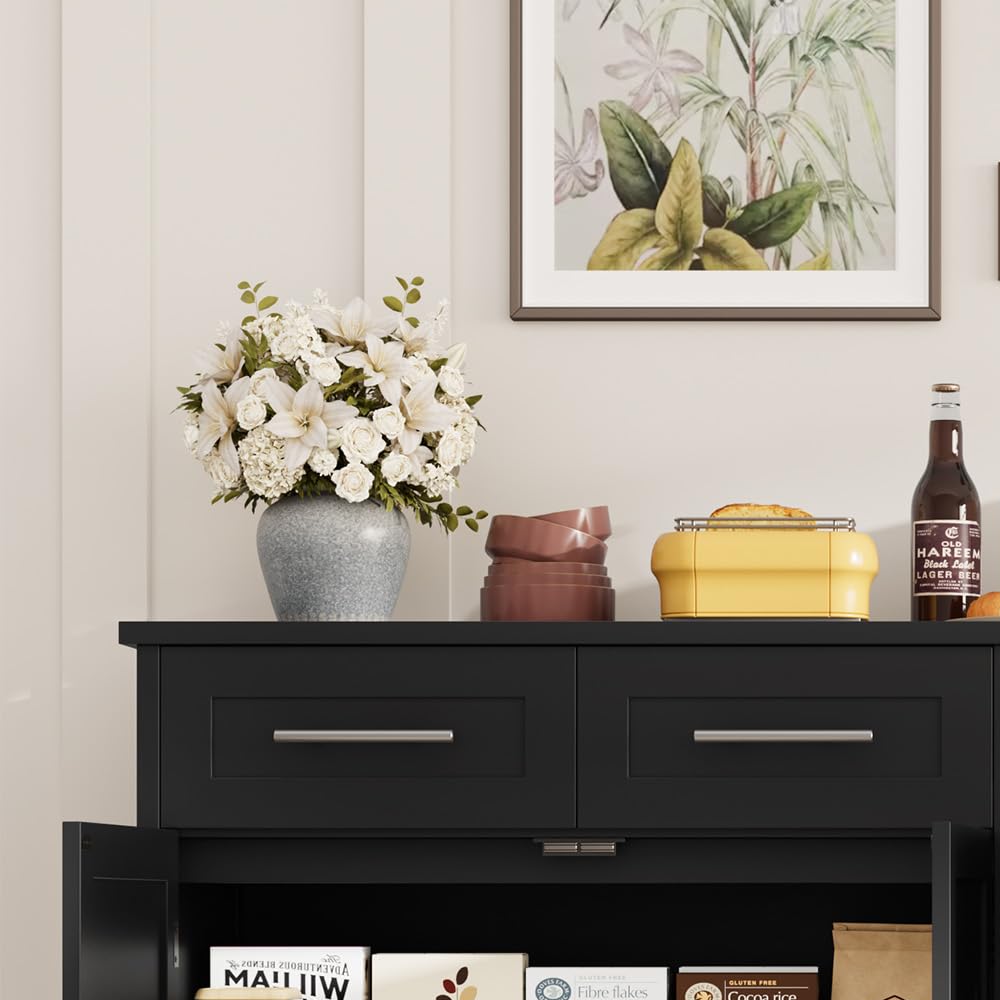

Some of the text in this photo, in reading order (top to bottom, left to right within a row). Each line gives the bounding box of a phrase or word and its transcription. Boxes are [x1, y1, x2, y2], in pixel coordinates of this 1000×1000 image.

[917, 547, 980, 559] HAREEM
[924, 559, 949, 569] Black
[917, 571, 952, 579] LAGER
[578, 985, 648, 999] Fibre flakes
